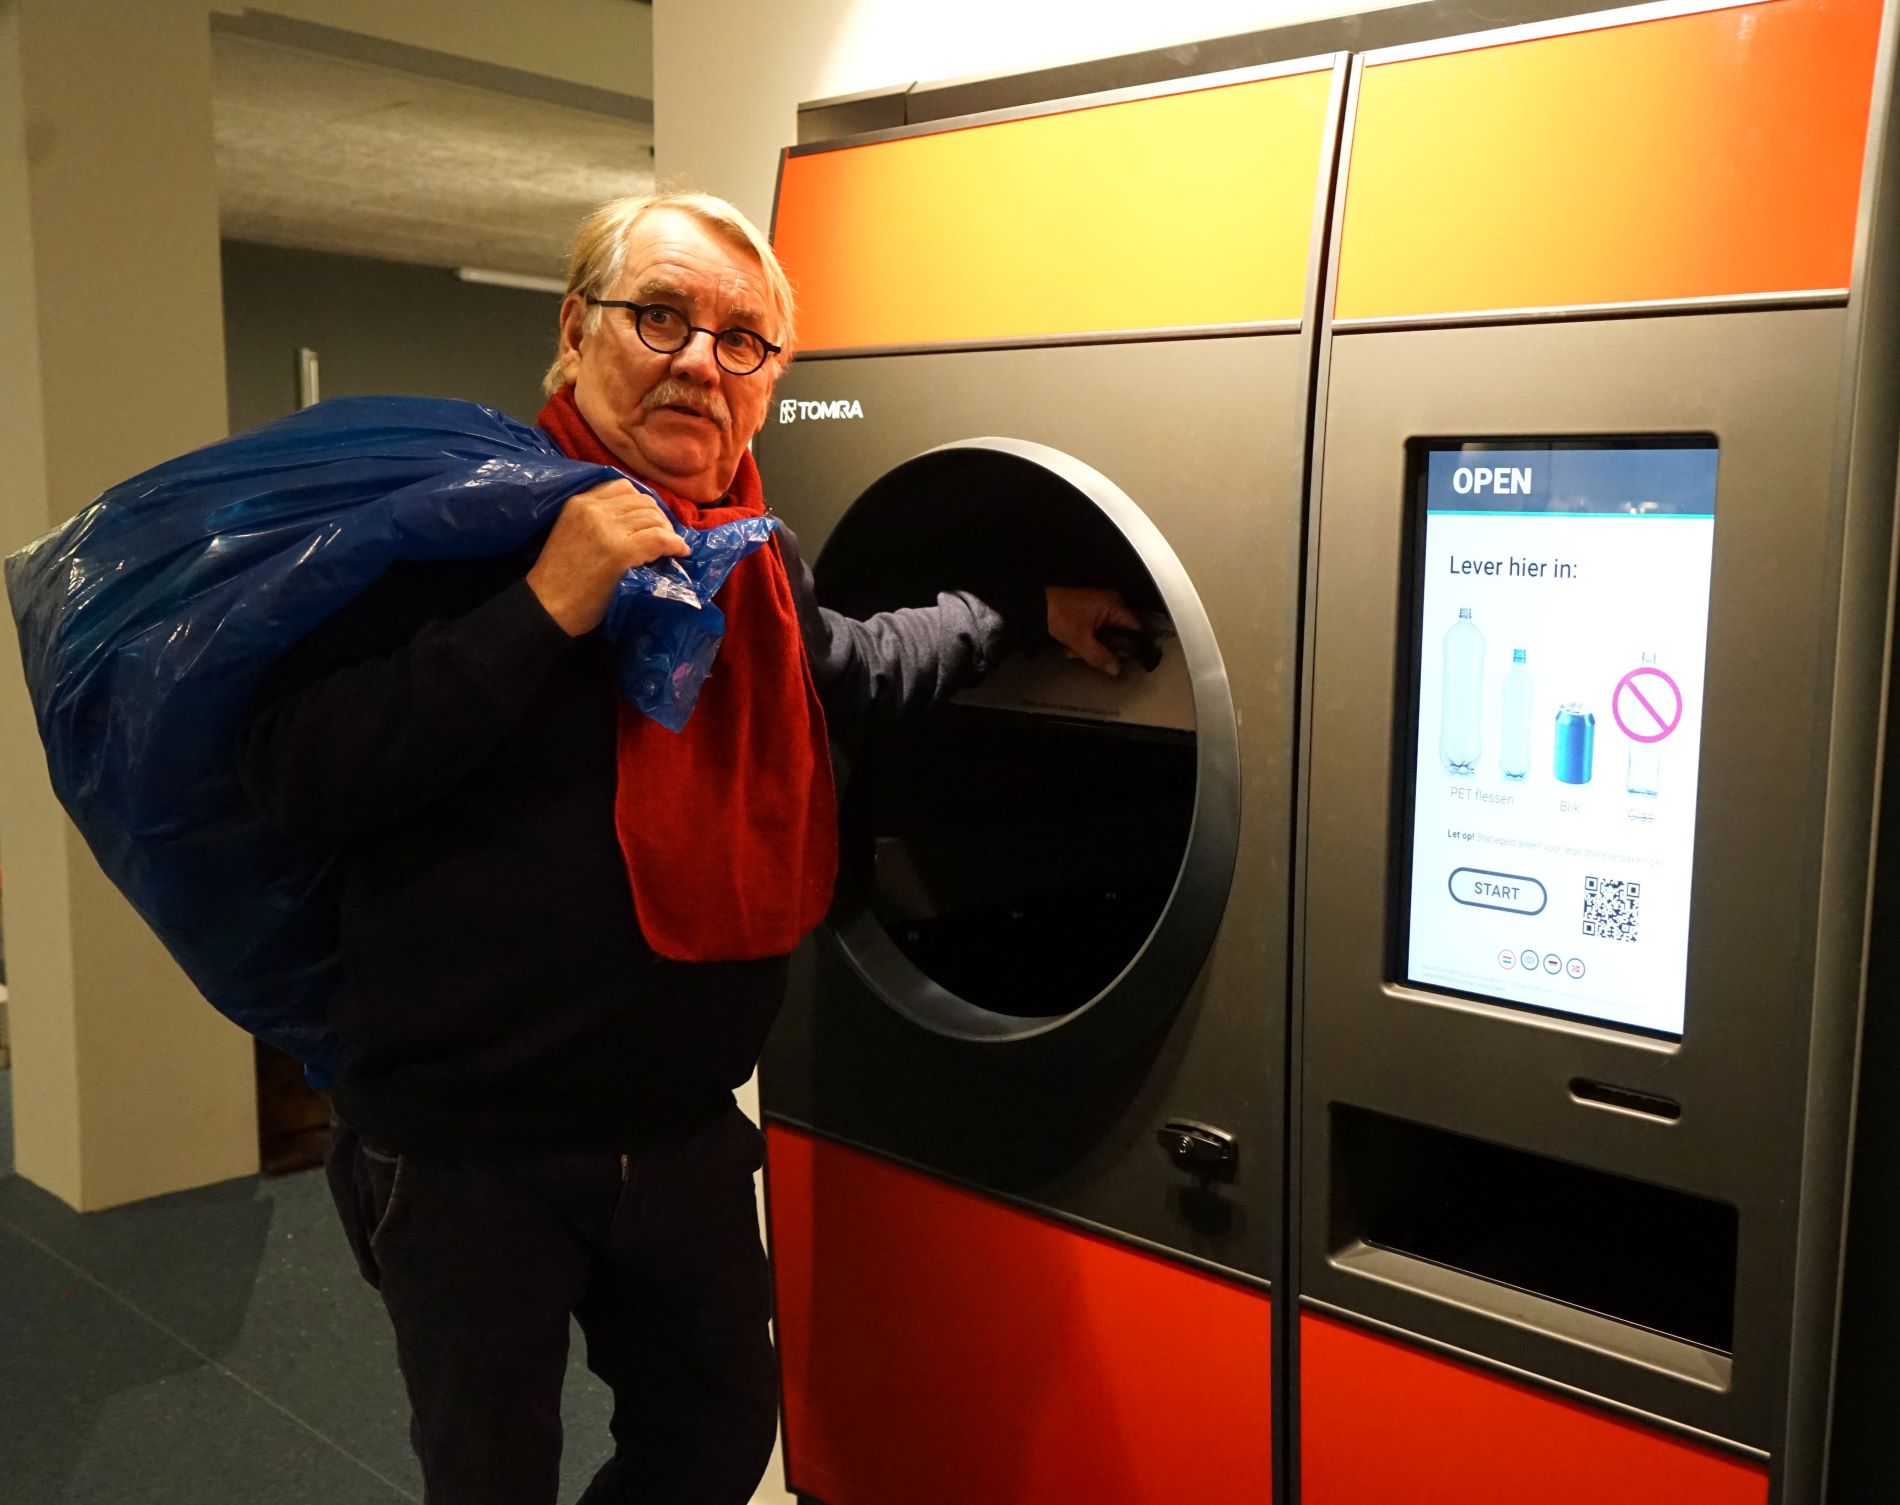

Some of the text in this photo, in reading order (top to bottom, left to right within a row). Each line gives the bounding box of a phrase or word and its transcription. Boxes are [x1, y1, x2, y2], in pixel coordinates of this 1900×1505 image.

[798, 400, 864, 420] TOMRA
[1452, 467, 1532, 494] OPEN
[1450, 556, 1577, 579] Lever hier in:
[1450, 787, 1514, 805] PET flessen
[1560, 800, 1580, 815] Blik
[1447, 829, 1461, 839] Let
[1462, 832, 1475, 842] op!
[1474, 881, 1520, 900] START
